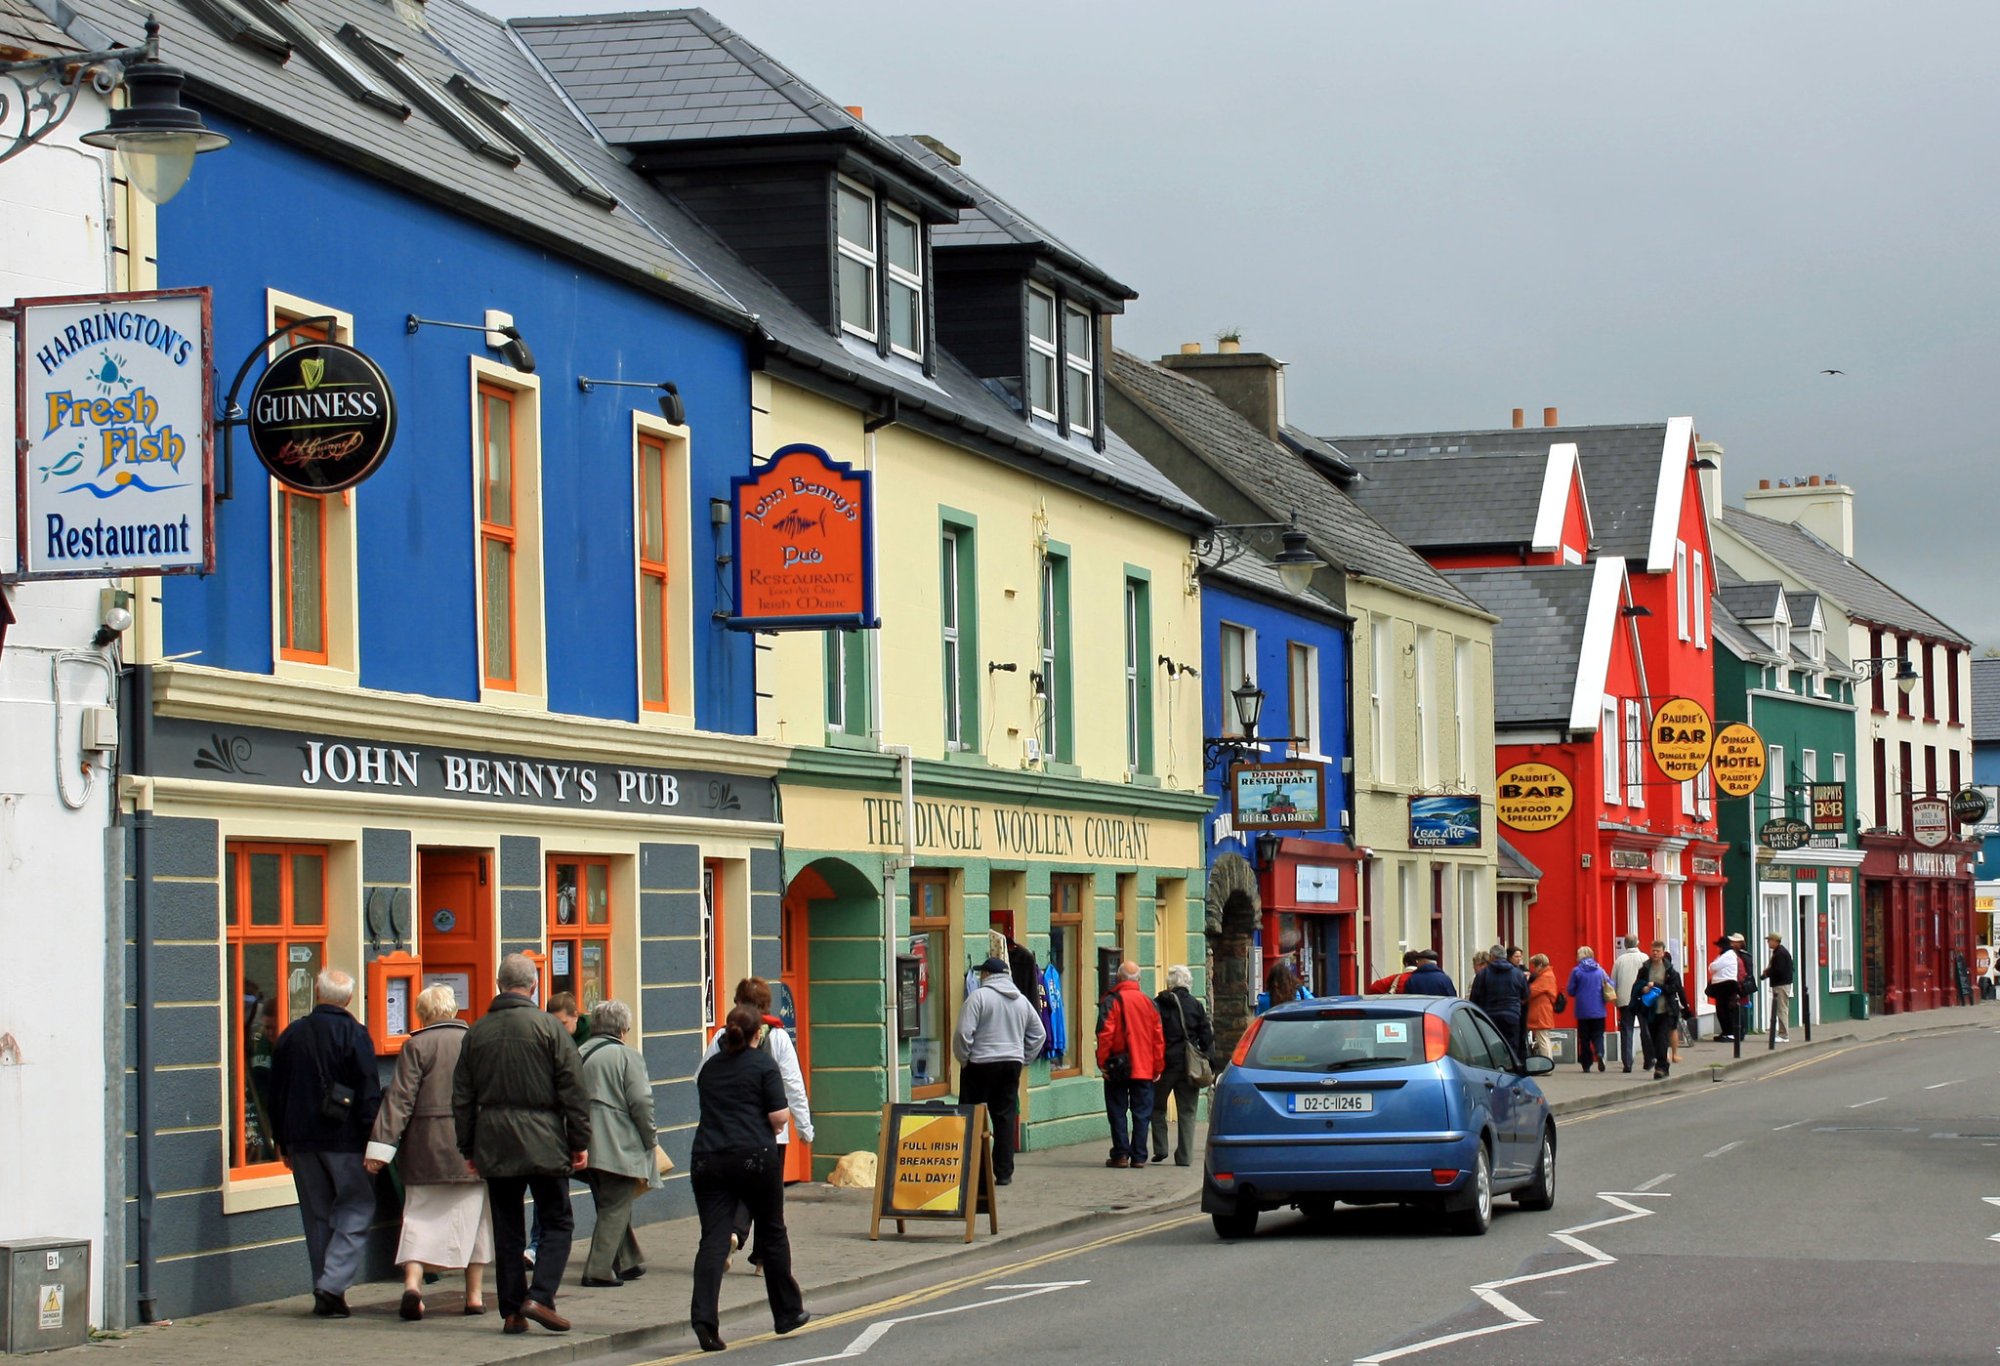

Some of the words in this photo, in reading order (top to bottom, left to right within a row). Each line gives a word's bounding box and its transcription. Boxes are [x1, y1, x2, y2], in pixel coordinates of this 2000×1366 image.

[36, 312, 193, 375] HARRINGTON'S
[256, 391, 378, 424] GUINNESS
[42, 386, 159, 441] Fresh
[97, 424, 186, 475] Fish
[745, 488, 787, 527] John
[789, 476, 858, 521] Benny's
[46, 513, 191, 560] Restaurant
[781, 545, 823, 569] Pub
[1662, 713, 1703, 723] PAUDIE'S
[1658, 727, 1706, 744] BAR
[1721, 736, 1755, 744] DINGLE
[1728, 746, 1748, 754] BAY
[1659, 752, 1686, 760] DINGLE
[1689, 752, 1705, 760] BAY
[1666, 761, 1698, 771] HOTEL
[1716, 755, 1761, 768] HOTEL
[302, 741, 420, 787] JOHN
[443, 755, 598, 803] BENNY'S
[618, 770, 680, 806] PUB
[1252, 770, 1303, 778] DANNO'S
[1511, 773, 1556, 782] PAUDIE'S
[1720, 773, 1758, 781] PAUDIE'S
[1241, 777, 1314, 786] RESTAURANT
[1499, 785, 1565, 799] BAR
[1500, 805, 1551, 813] SEAFOOD
[1242, 814, 1269, 822] BEER
[1271, 813, 1316, 822] GARDEN
[1507, 814, 1559, 822] SPECIALITY
[863, 797, 903, 846] THE
[913, 801, 982, 850] DINGLE
[994, 809, 1074, 856] WOOLLEN
[1084, 816, 1150, 860] COMPANY
[1384, 1025, 1399, 1037] L
[1304, 1097, 1362, 1110] 02-C-11246
[902, 1142, 927, 1150] FULL
[931, 1142, 959, 1151] IRISH
[900, 1157, 959, 1166] BREAKFAST
[900, 1173, 921, 1183] ALL
[925, 1173, 956, 1183] DAY!!
[48, 1256, 58, 1265] B1
